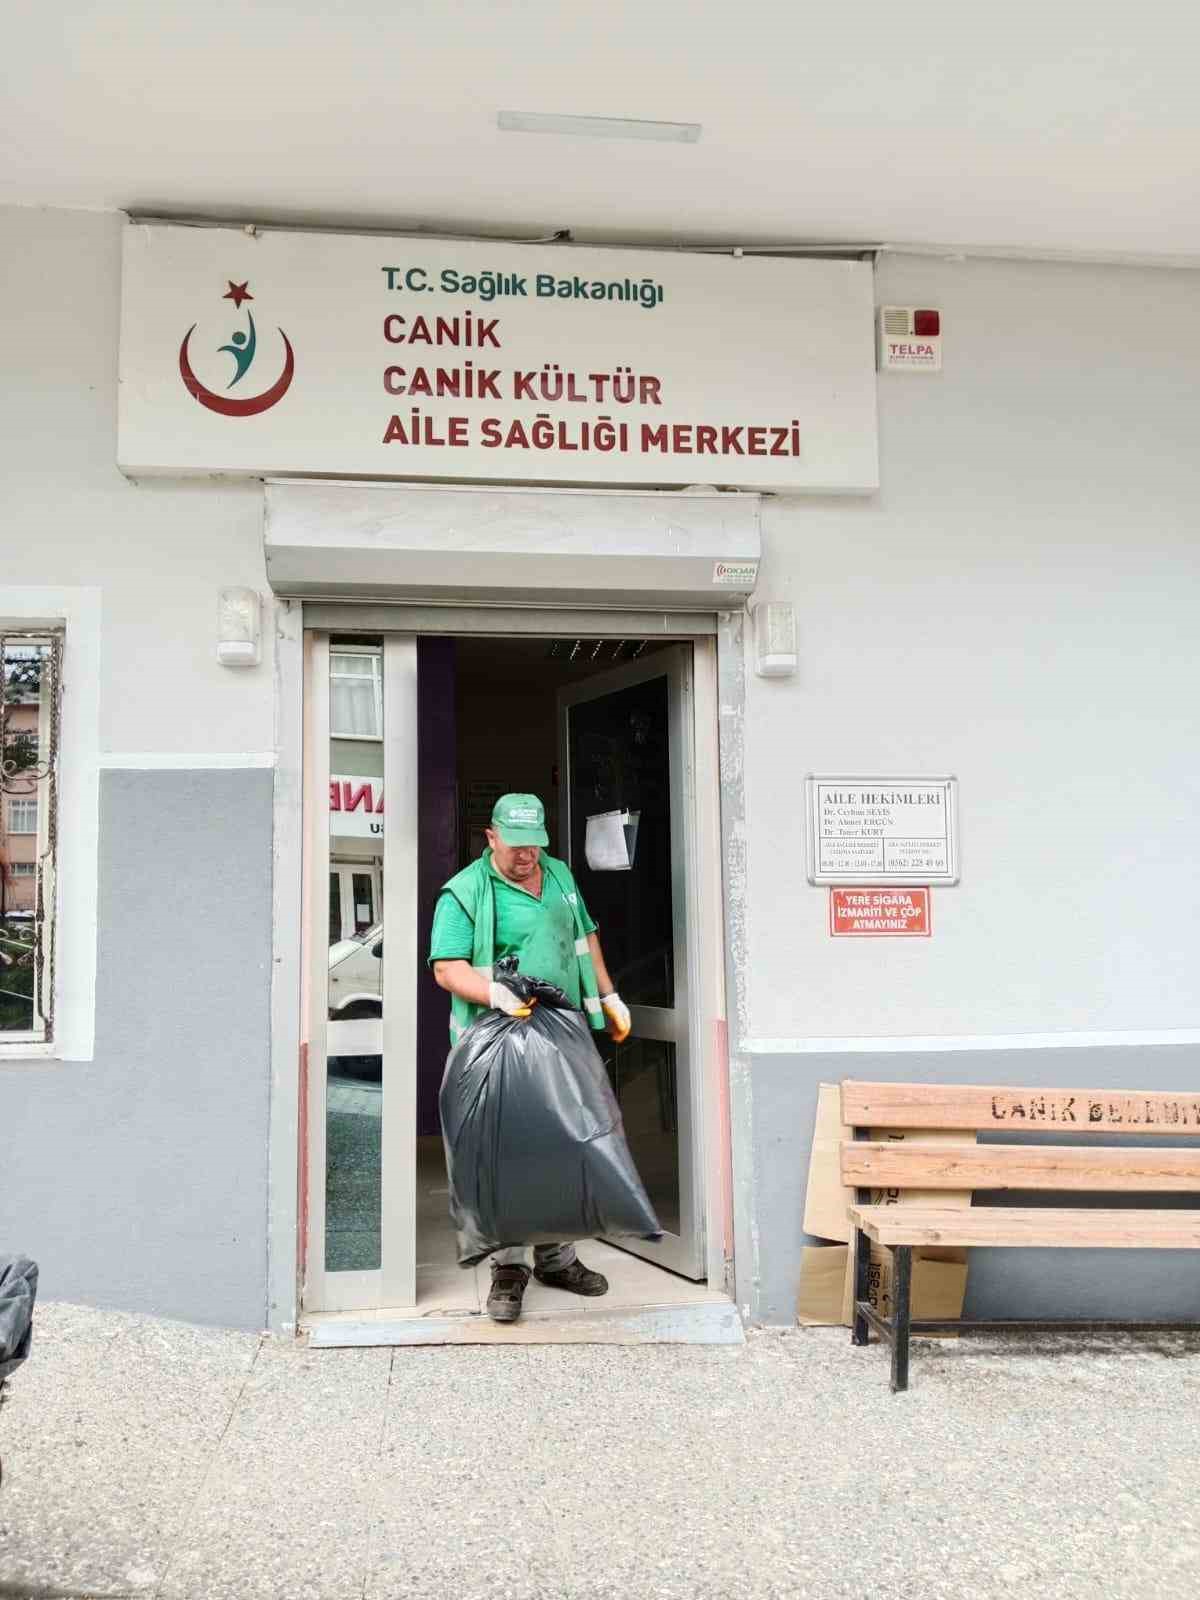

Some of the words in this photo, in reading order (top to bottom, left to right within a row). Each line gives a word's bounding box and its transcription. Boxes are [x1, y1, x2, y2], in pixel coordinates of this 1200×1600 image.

[382, 267, 434, 292] T.C.
[440, 269, 528, 301] Sağlık
[536, 273, 664, 308] Bakanlığı
[383, 310, 502, 348] CANİK
[383, 361, 502, 400] CANİK
[514, 363, 662, 405] KÜLTÜR
[382, 407, 469, 446] AİLE
[480, 413, 628, 452] SAĞLIĞI
[640, 419, 800, 457] MERKEZİ
[824, 790, 857, 805] AİLE
[861, 790, 941, 805] HEKİMLERİ
[838, 905, 881, 918] İZMARİTİ
[885, 907, 897, 917] VE
[900, 905, 922, 919] ÇÖP
[845, 895, 871, 905] YERE
[873, 893, 912, 905] SİGARA
[853, 919, 907, 929] ATMAYINIZ
